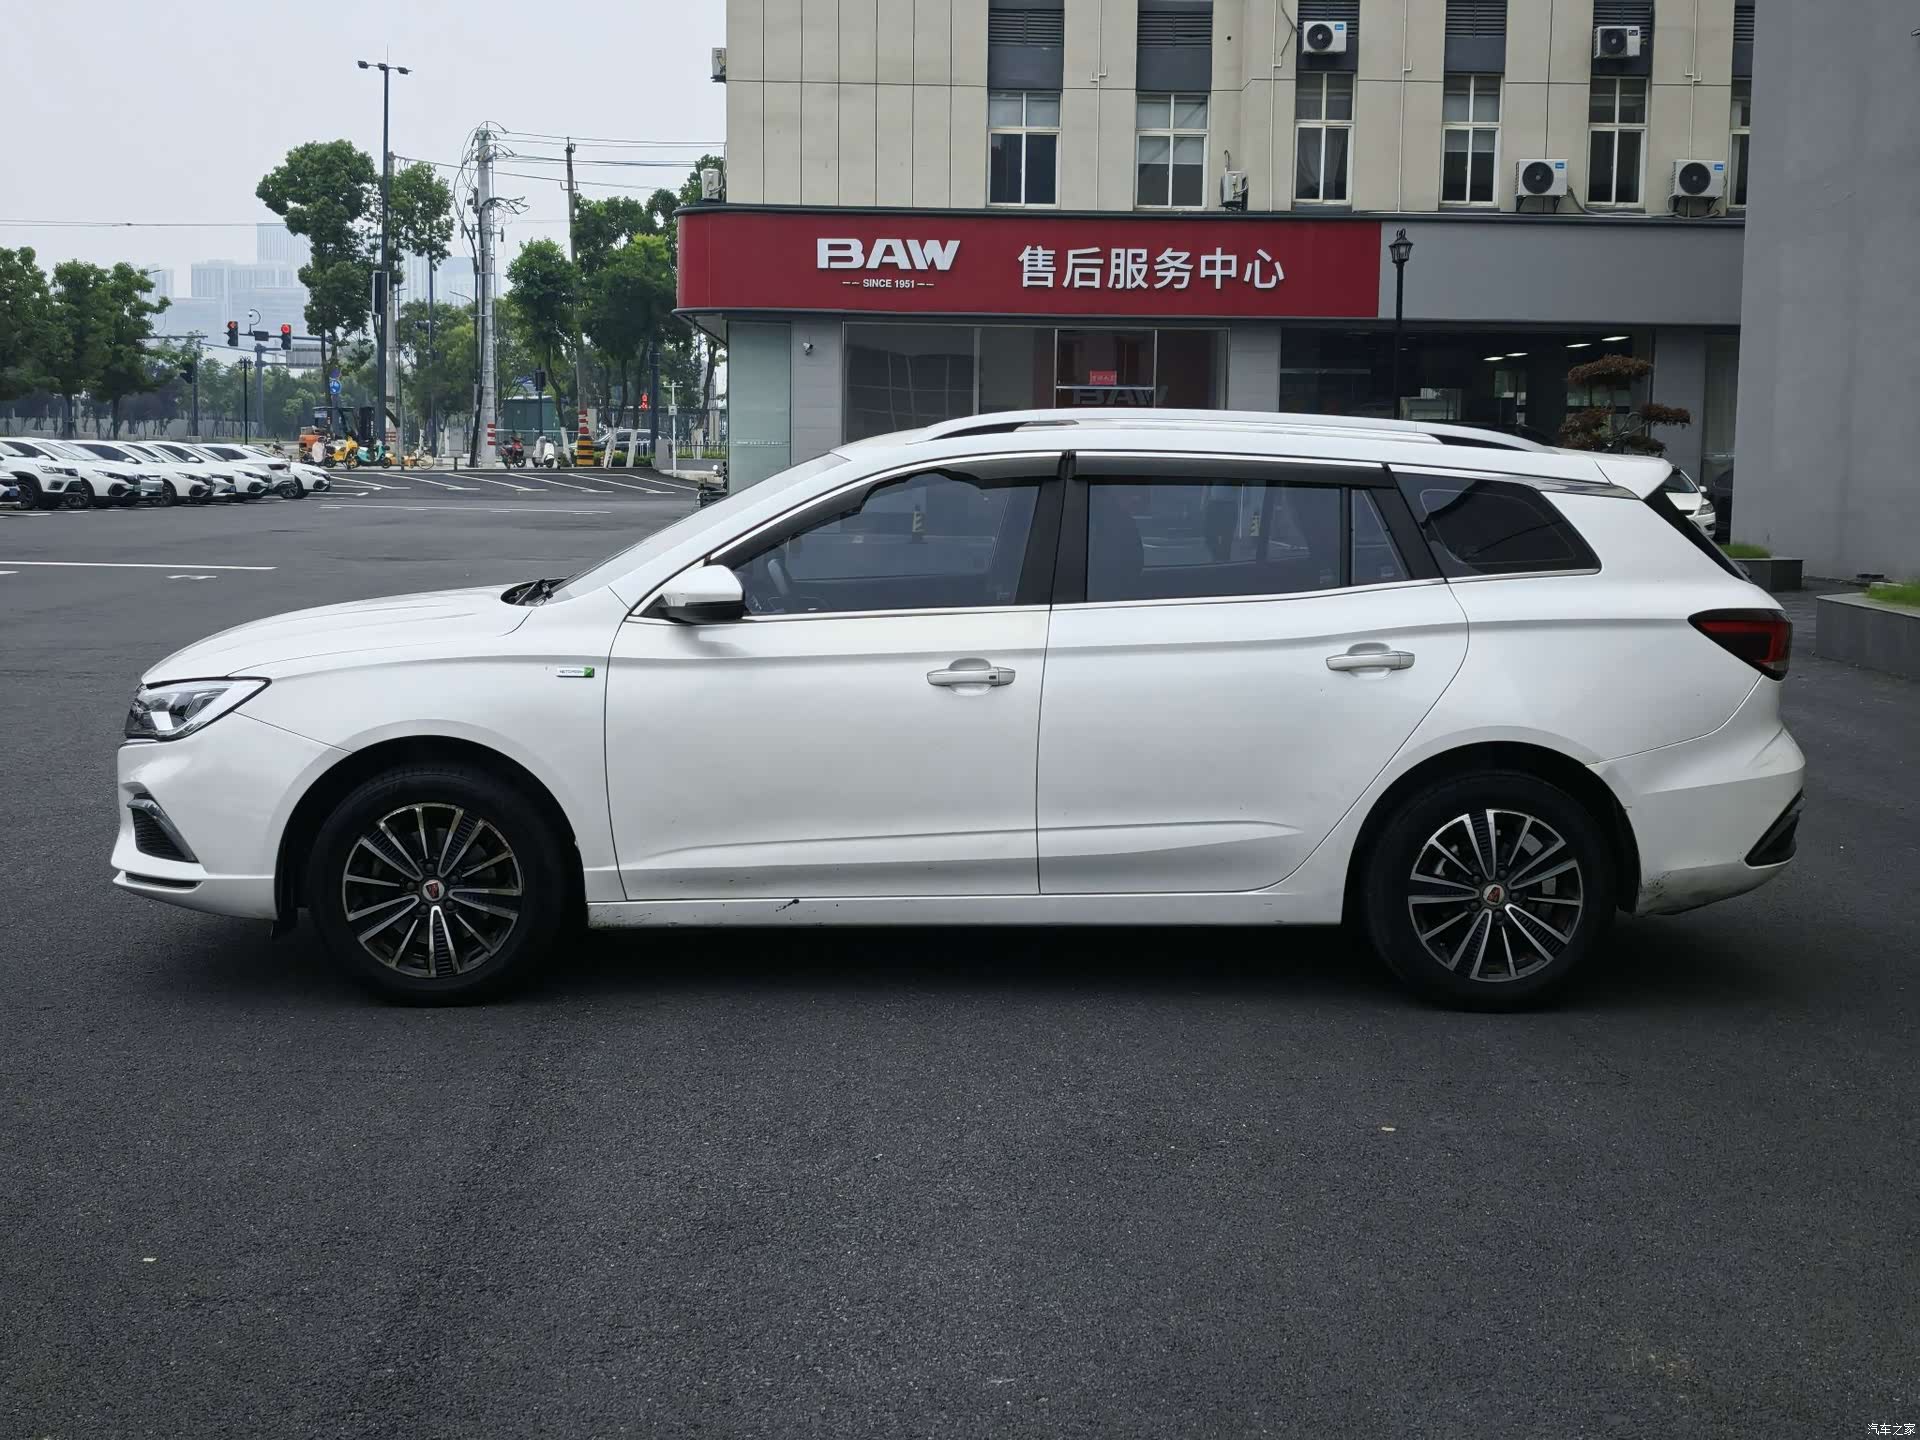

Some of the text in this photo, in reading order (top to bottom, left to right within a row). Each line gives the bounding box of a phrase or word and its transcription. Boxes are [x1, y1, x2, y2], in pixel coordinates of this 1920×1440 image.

[816, 237, 960, 271] BAW
[1017, 245, 1285, 290] 售后服务中心
[862, 278, 914, 289] SINCE 1951
